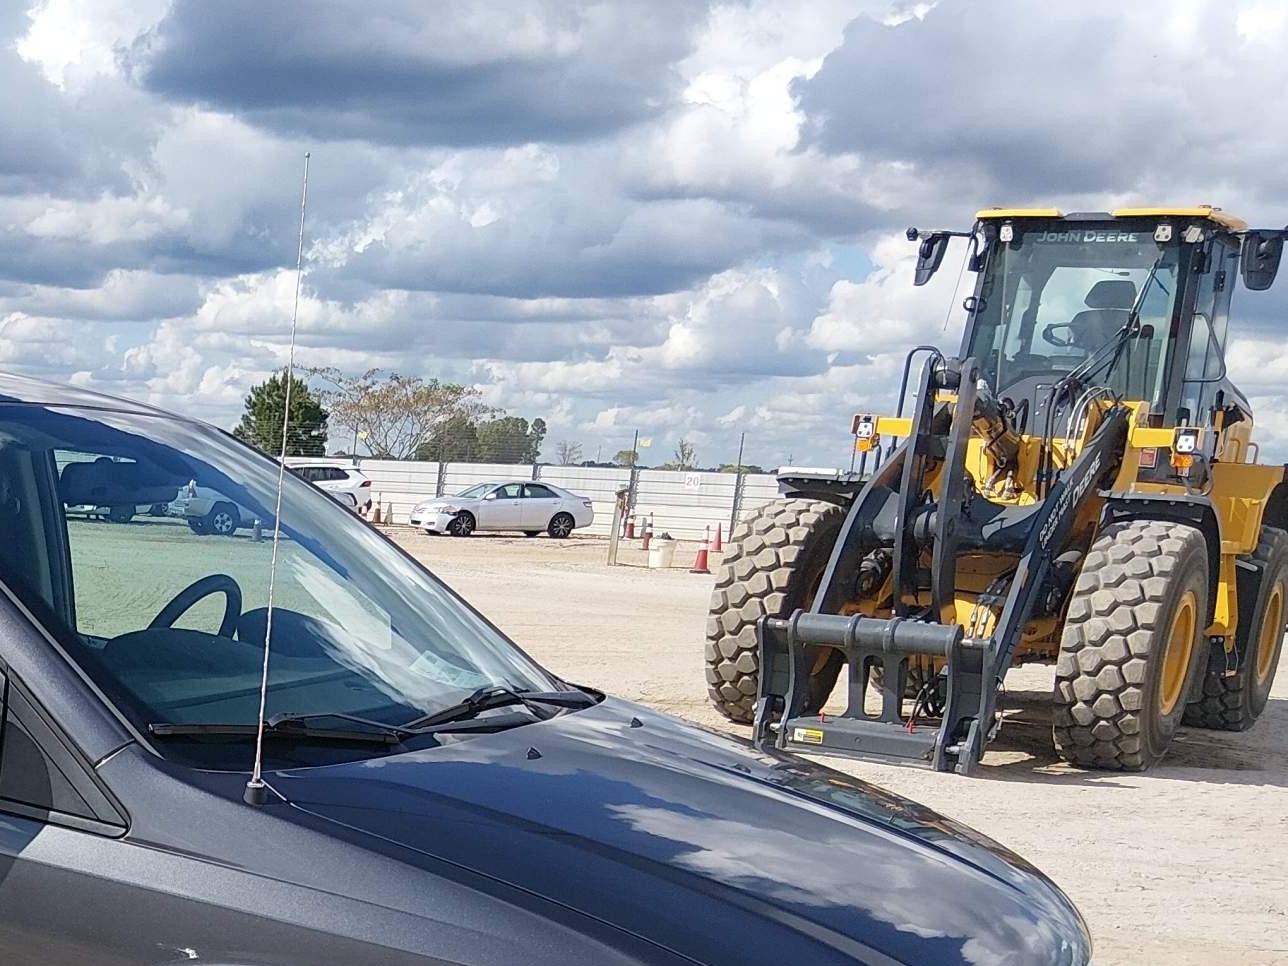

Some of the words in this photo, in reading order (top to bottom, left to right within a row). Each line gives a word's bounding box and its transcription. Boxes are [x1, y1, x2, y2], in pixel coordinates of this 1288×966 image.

[1037, 230, 1081, 242] JOHN
[1083, 230, 1138, 242] DEERE
[686, 476, 700, 487] 20
[1072, 450, 1102, 510] DEERE
